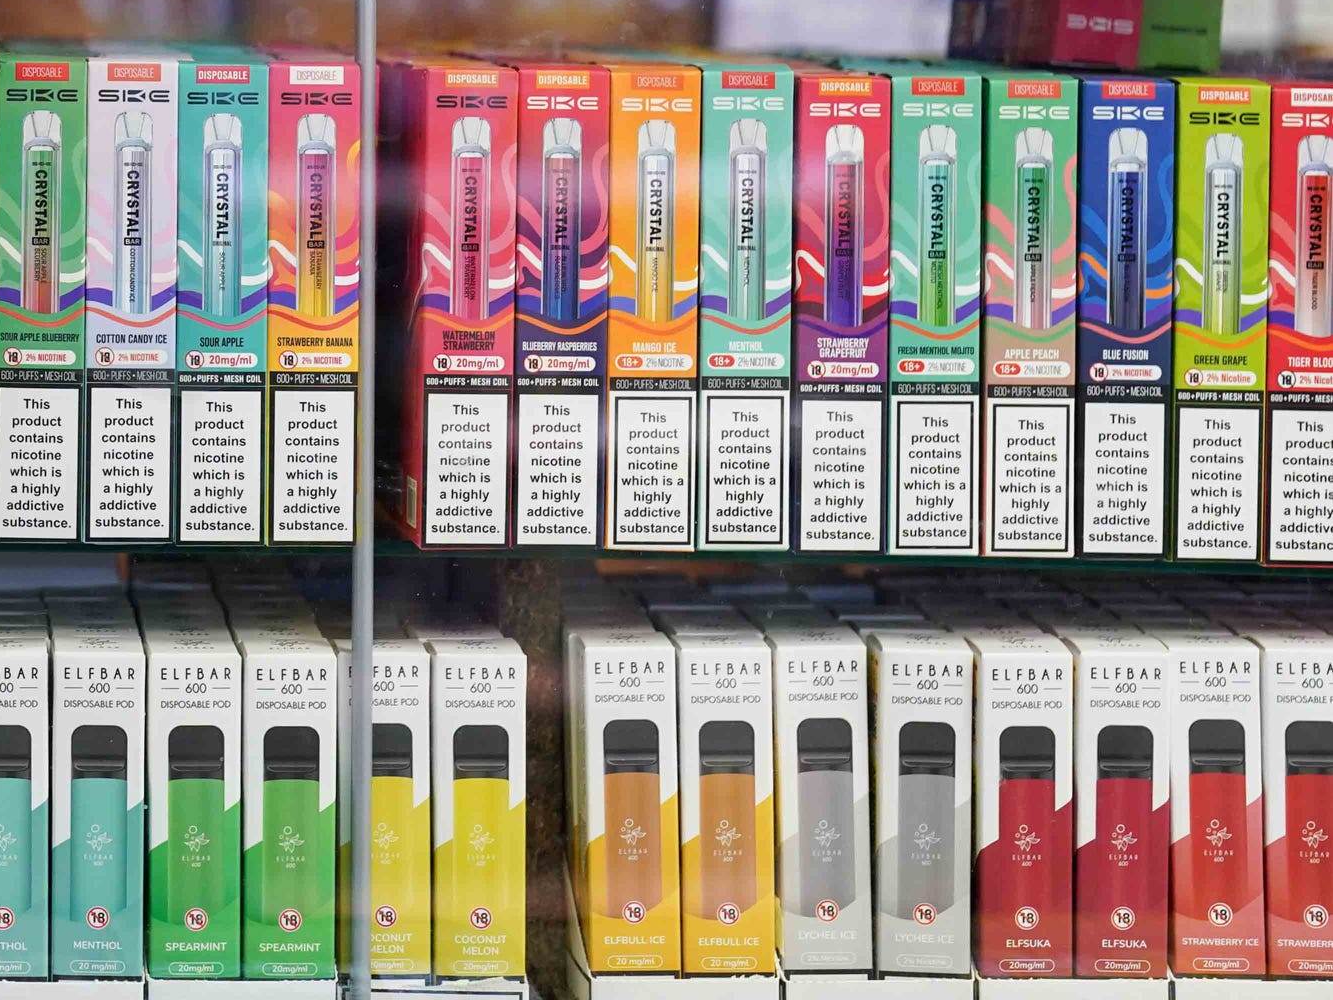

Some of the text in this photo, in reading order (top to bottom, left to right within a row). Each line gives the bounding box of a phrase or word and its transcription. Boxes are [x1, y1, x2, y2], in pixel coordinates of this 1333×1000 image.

[1200, 91, 1250, 102] DISPOSABLE
[1189, 112, 1260, 126] SKE
[126, 170, 140, 237] CRYSTAL
[96, 333, 167, 344] COTTON CANDY ICE
[817, 337, 869, 348] STRAWBERRY
[632, 342, 677, 353] MANGO ICE
[819, 348, 867, 359] GRAPEFRUIT
[1102, 349, 1149, 360] BLUE FUSION
[1193, 354, 1248, 366] GREEN GRAPE
[1018, 419, 1045, 431] This
[1006, 436, 1056, 447] product
[1004, 451, 1058, 463] contains
[1006, 466, 1056, 478] nicotine
[999, 482, 1062, 494] which is a
[1011, 498, 1050, 512] highly
[1002, 514, 1059, 525] addictive
[997, 530, 1063, 541] substance
[992, 668, 1063, 681] ELFBAR
[604, 935, 666, 945] ELFBULL ICE
[1005, 939, 1052, 949] ELFSUKA
[1181, 937, 1259, 947] STRAWBERRY ICE
[165, 941, 227, 952] SPEARMINT
